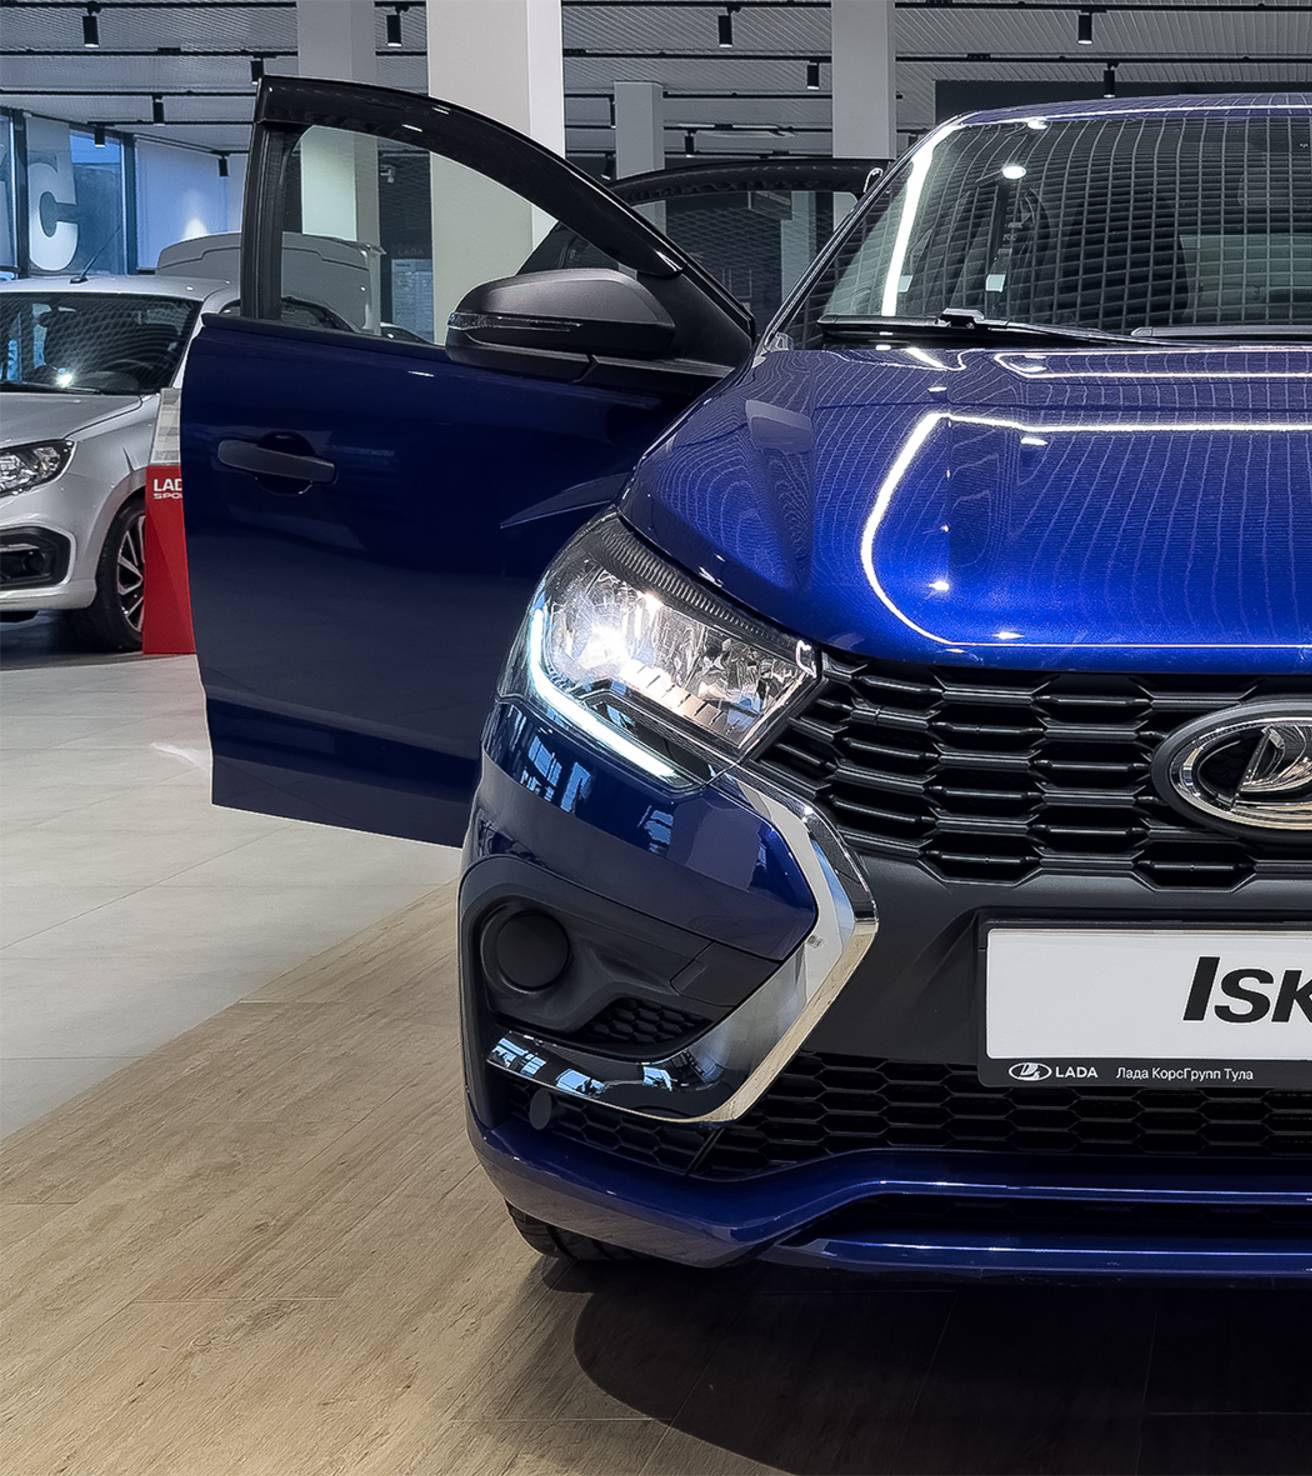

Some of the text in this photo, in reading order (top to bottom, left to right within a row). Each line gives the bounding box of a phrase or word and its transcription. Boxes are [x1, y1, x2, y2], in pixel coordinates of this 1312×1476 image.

[153, 479, 183, 492] LAD
[153, 492, 183, 500] SPO
[1055, 1066, 1098, 1079] LADA
[1116, 1066, 1254, 1082] Лада КорсГрупп Тула
